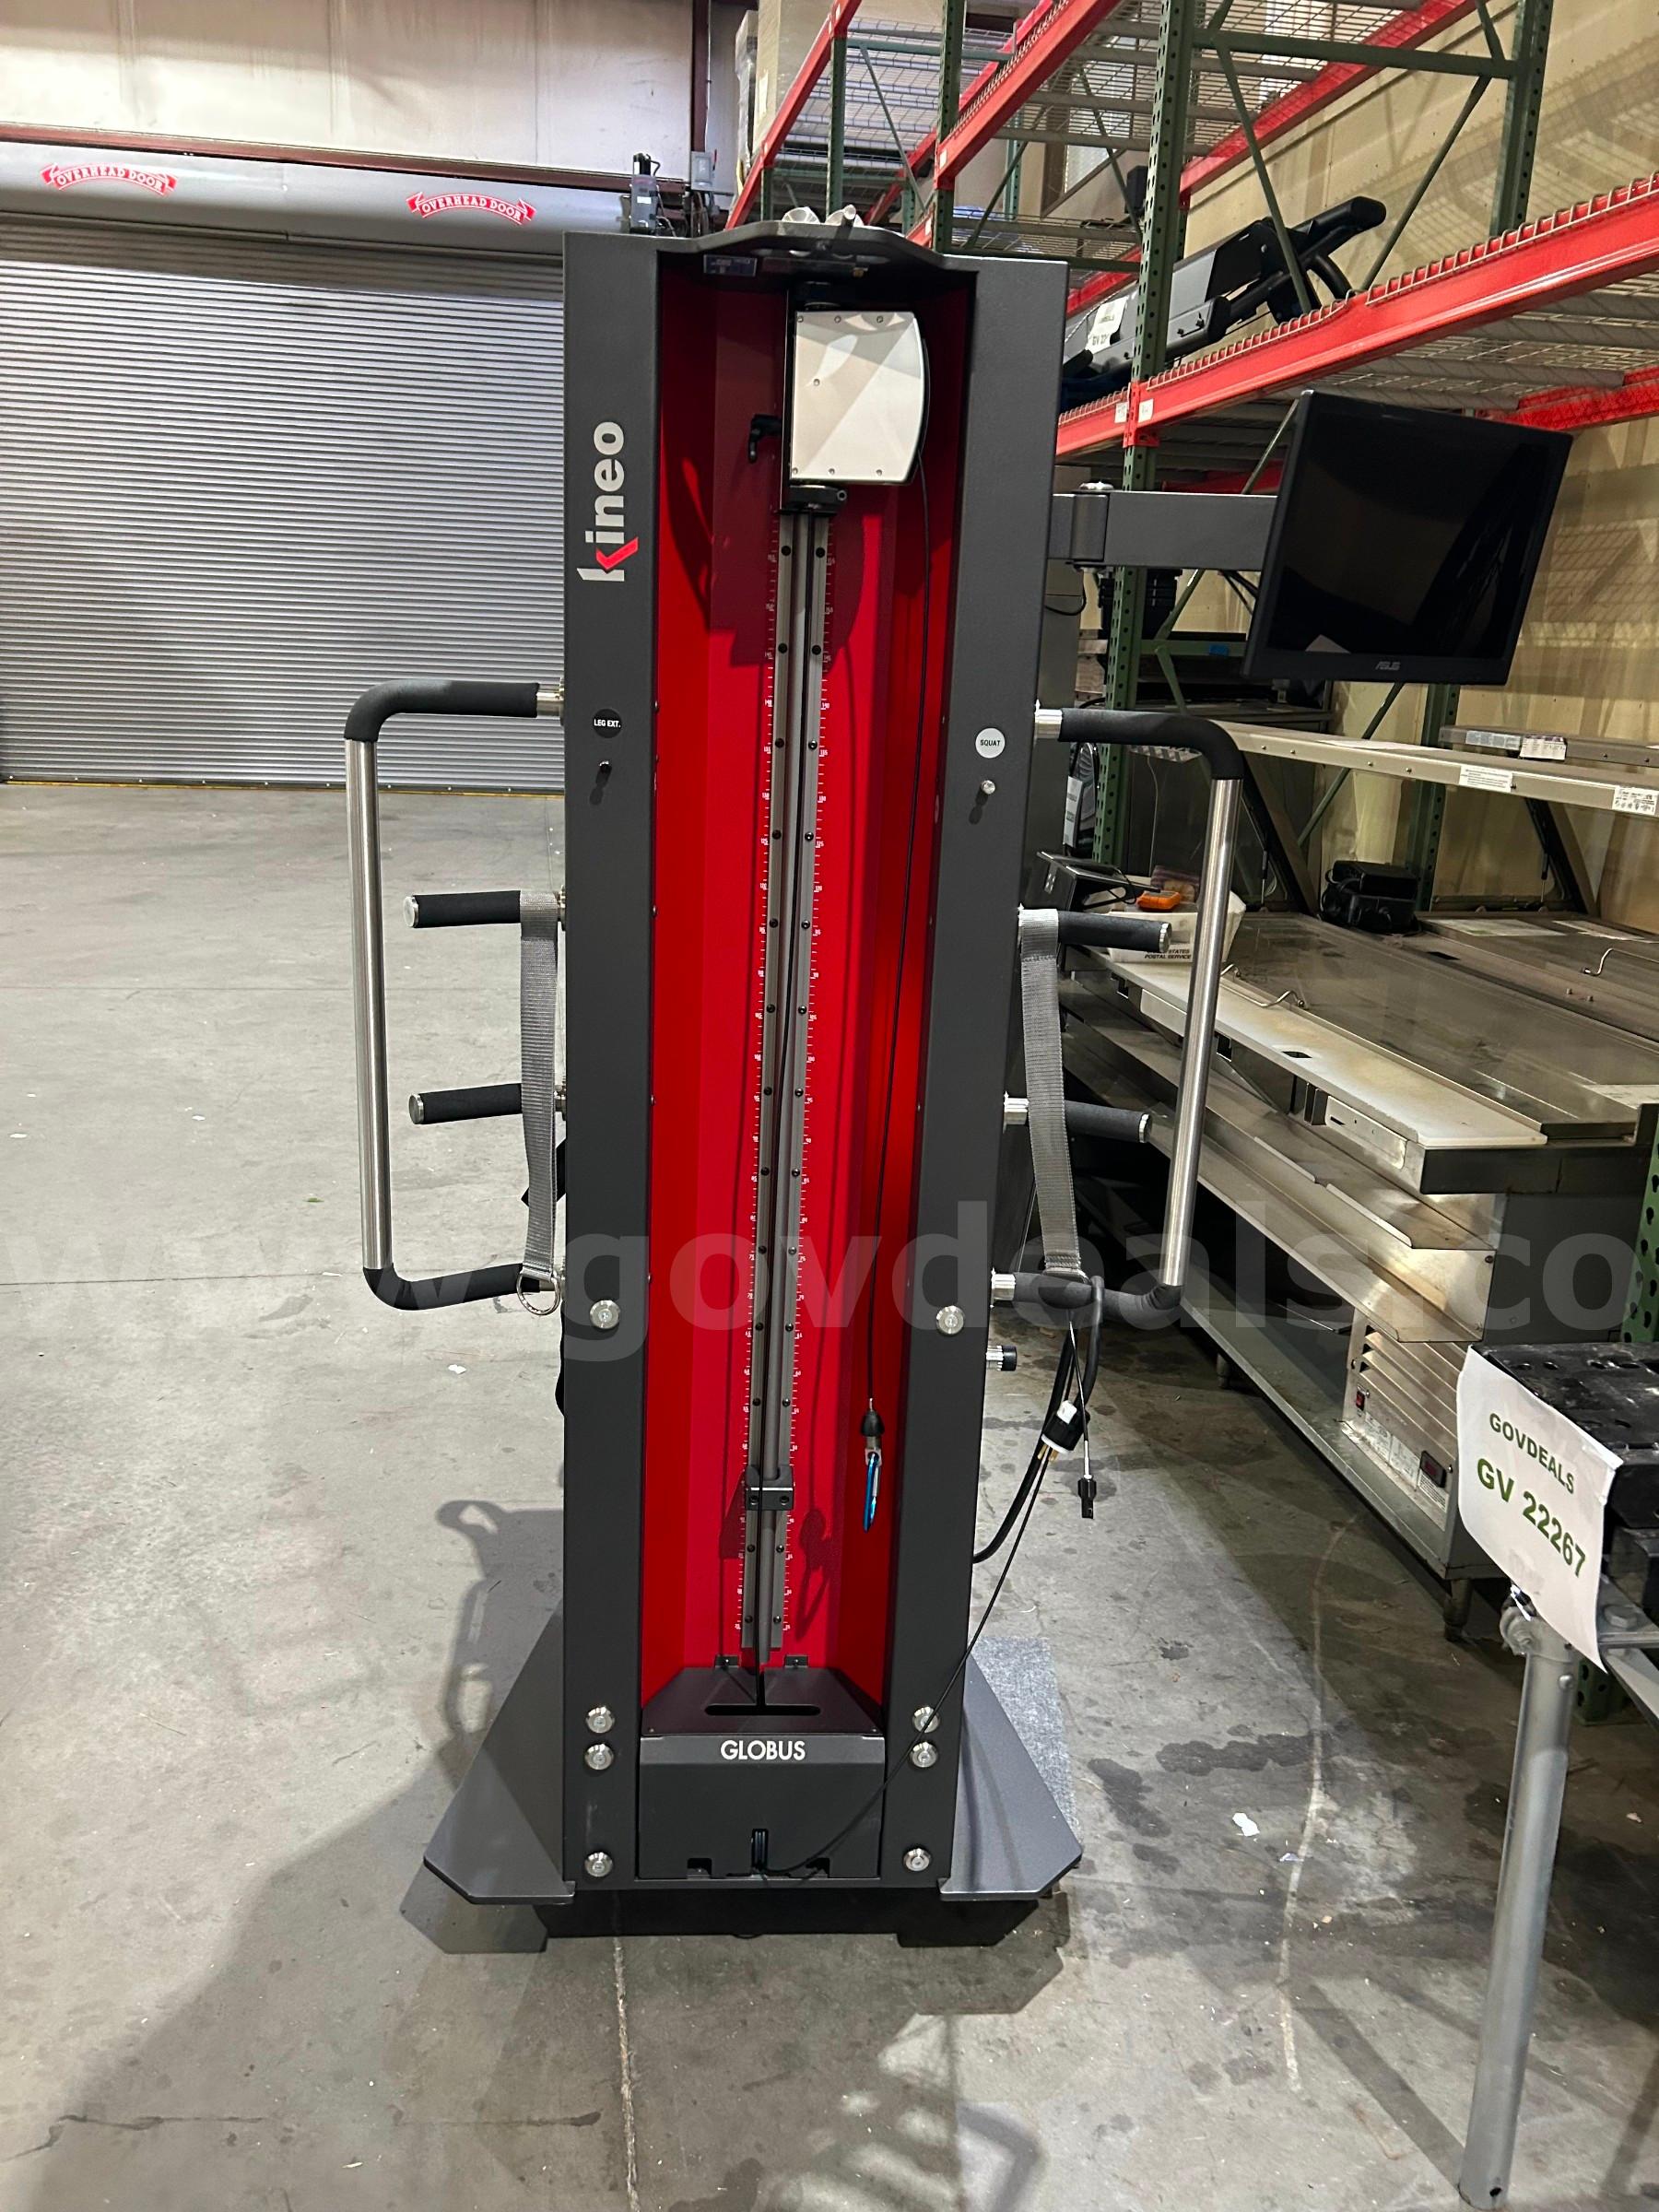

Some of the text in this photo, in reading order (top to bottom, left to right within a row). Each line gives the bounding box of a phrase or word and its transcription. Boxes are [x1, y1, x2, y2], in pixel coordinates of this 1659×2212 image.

[57, 166, 163, 191] OVERHEAD DOOR
[421, 195, 522, 220] OVERHEAD DOOR
[576, 421, 639, 582] kineo
[1374, 661, 1401, 671] ASUS
[606, 720, 621, 728] EXT.
[1489, 1412, 1575, 1495] GOVDEALS
[1477, 1458, 1515, 1503] GV
[1522, 1490, 1586, 1578] 22267
[720, 1739, 806, 1761] GLOBUS
